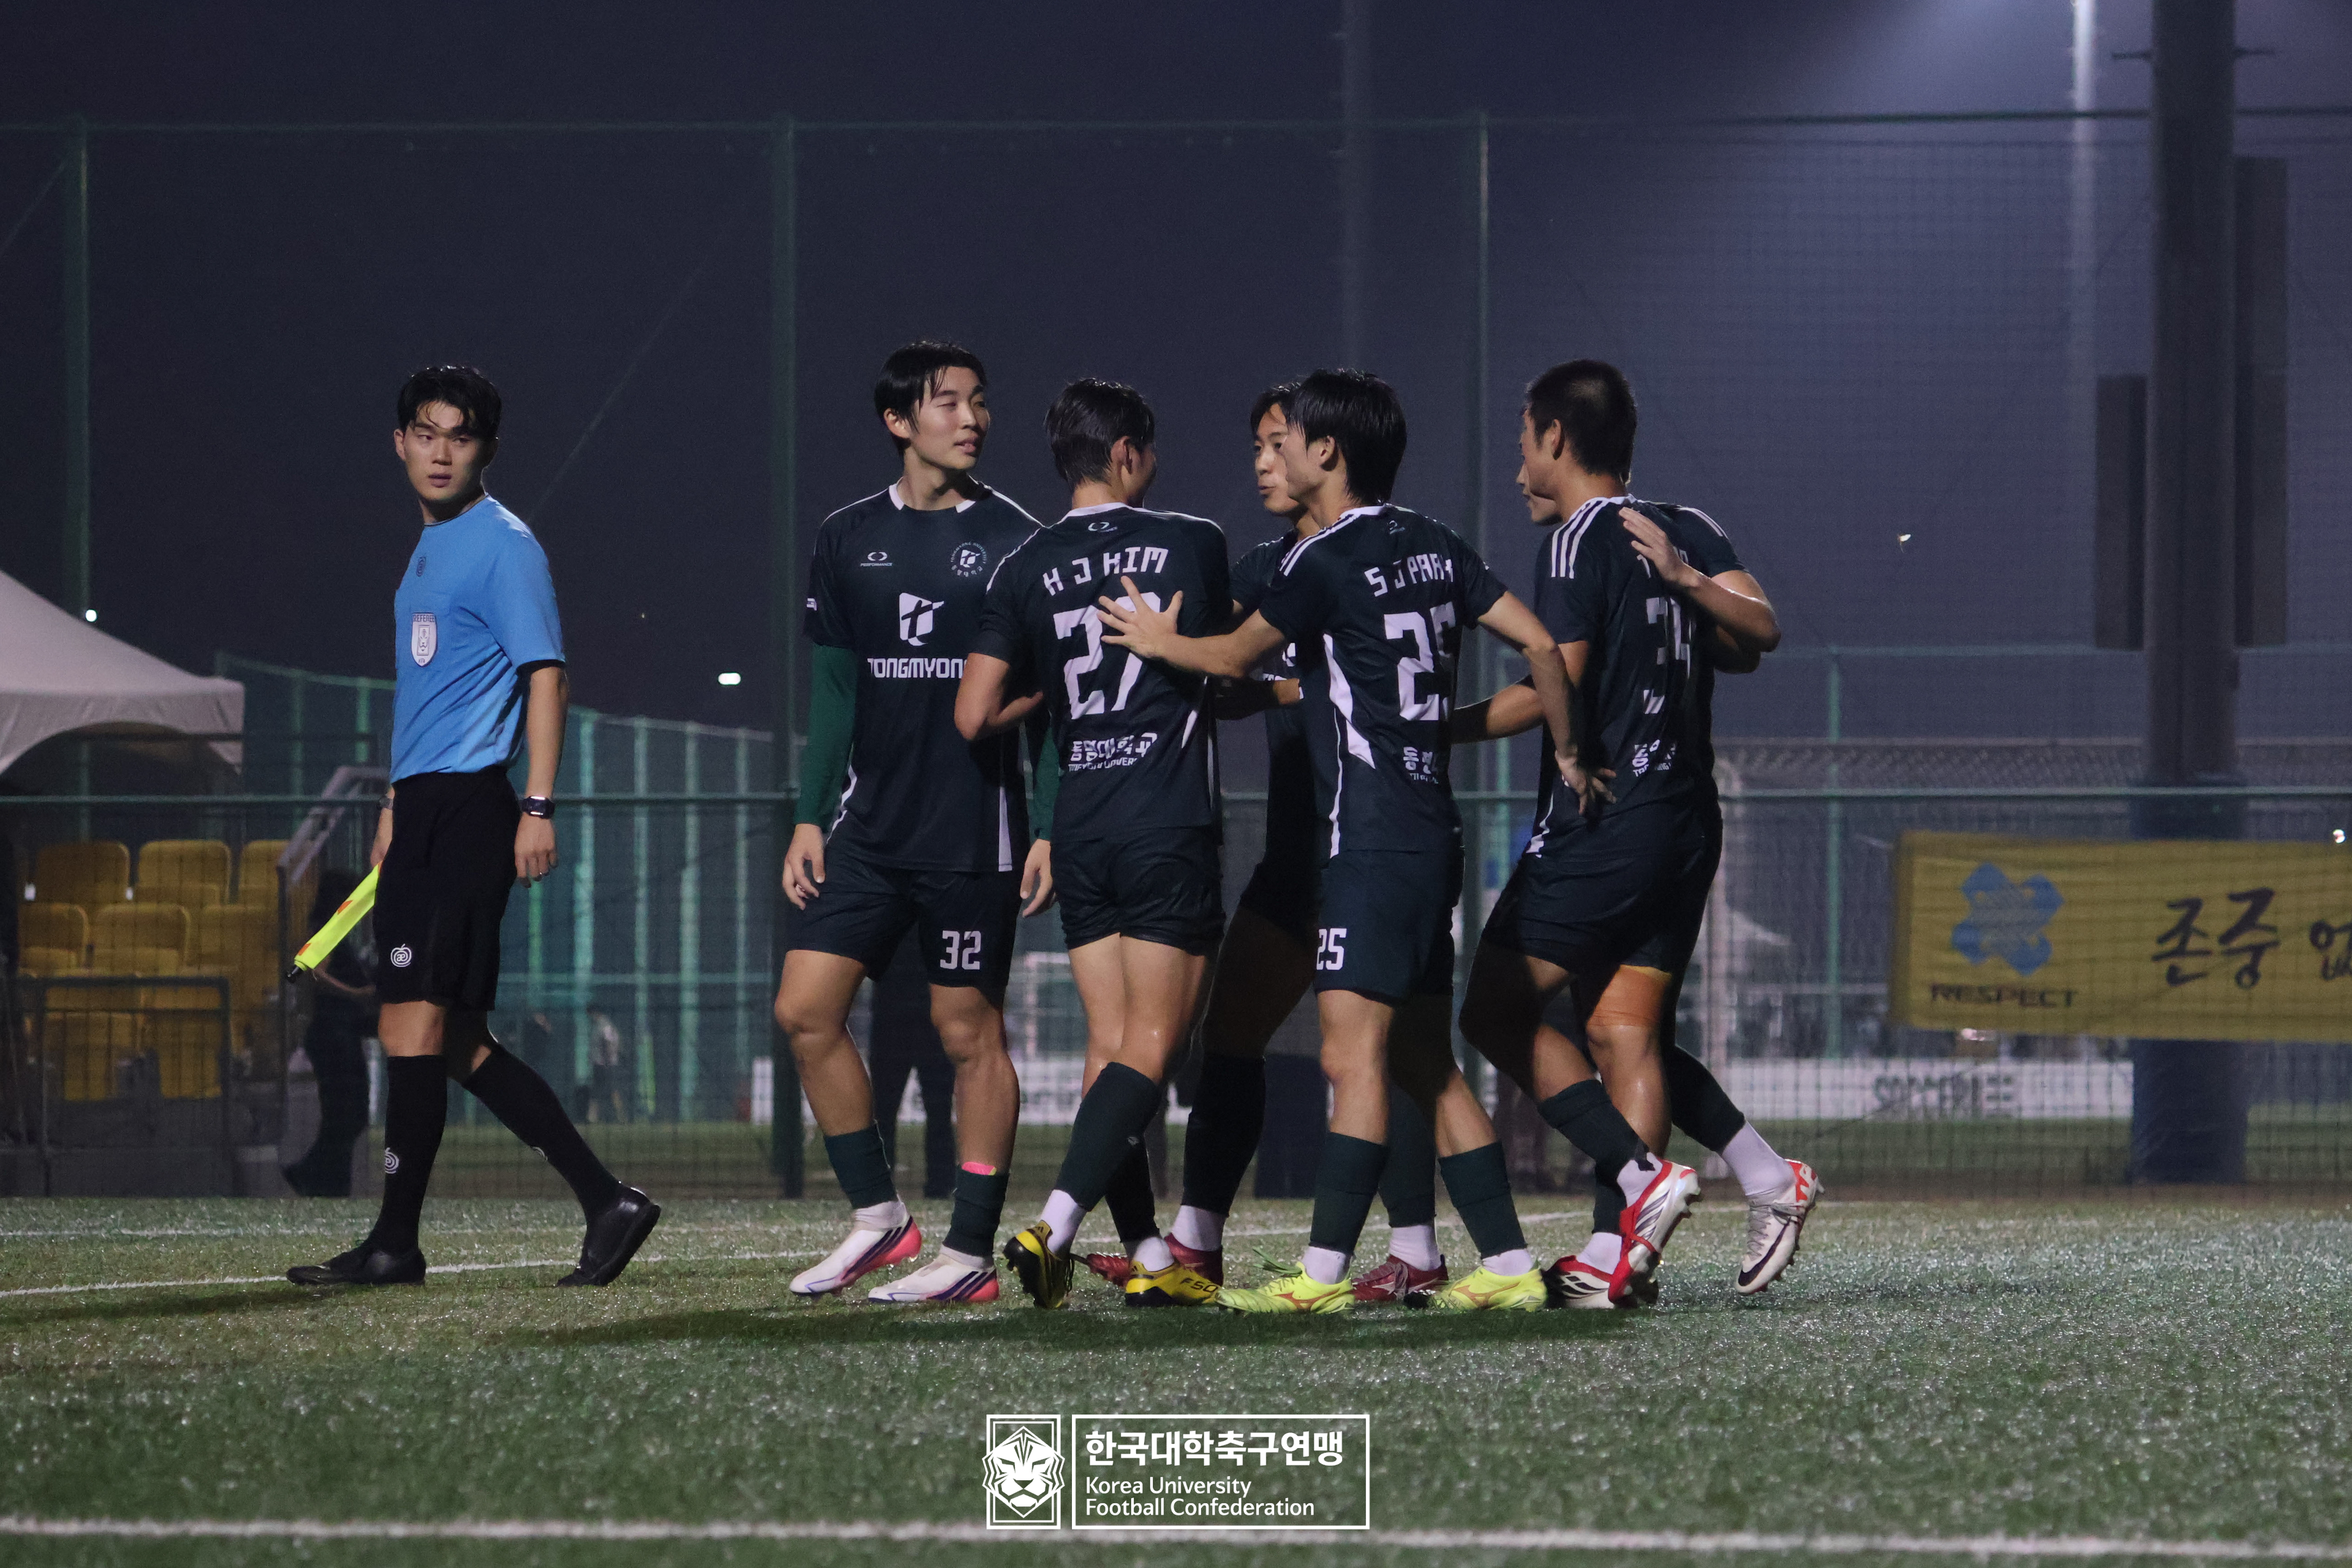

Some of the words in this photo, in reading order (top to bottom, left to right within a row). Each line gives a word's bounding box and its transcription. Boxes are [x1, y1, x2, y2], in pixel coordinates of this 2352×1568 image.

[1043, 567, 1064, 596] H
[1071, 557, 1092, 585] J
[1364, 566, 1388, 597] S
[413, 614, 436, 623] REFEREE
[867, 657, 967, 679] TONGMYON
[940, 930, 982, 970] 32
[1316, 928, 1347, 970] 25
[2152, 887, 2281, 989] 존중
[1930, 982, 2080, 1008] RESPECT
